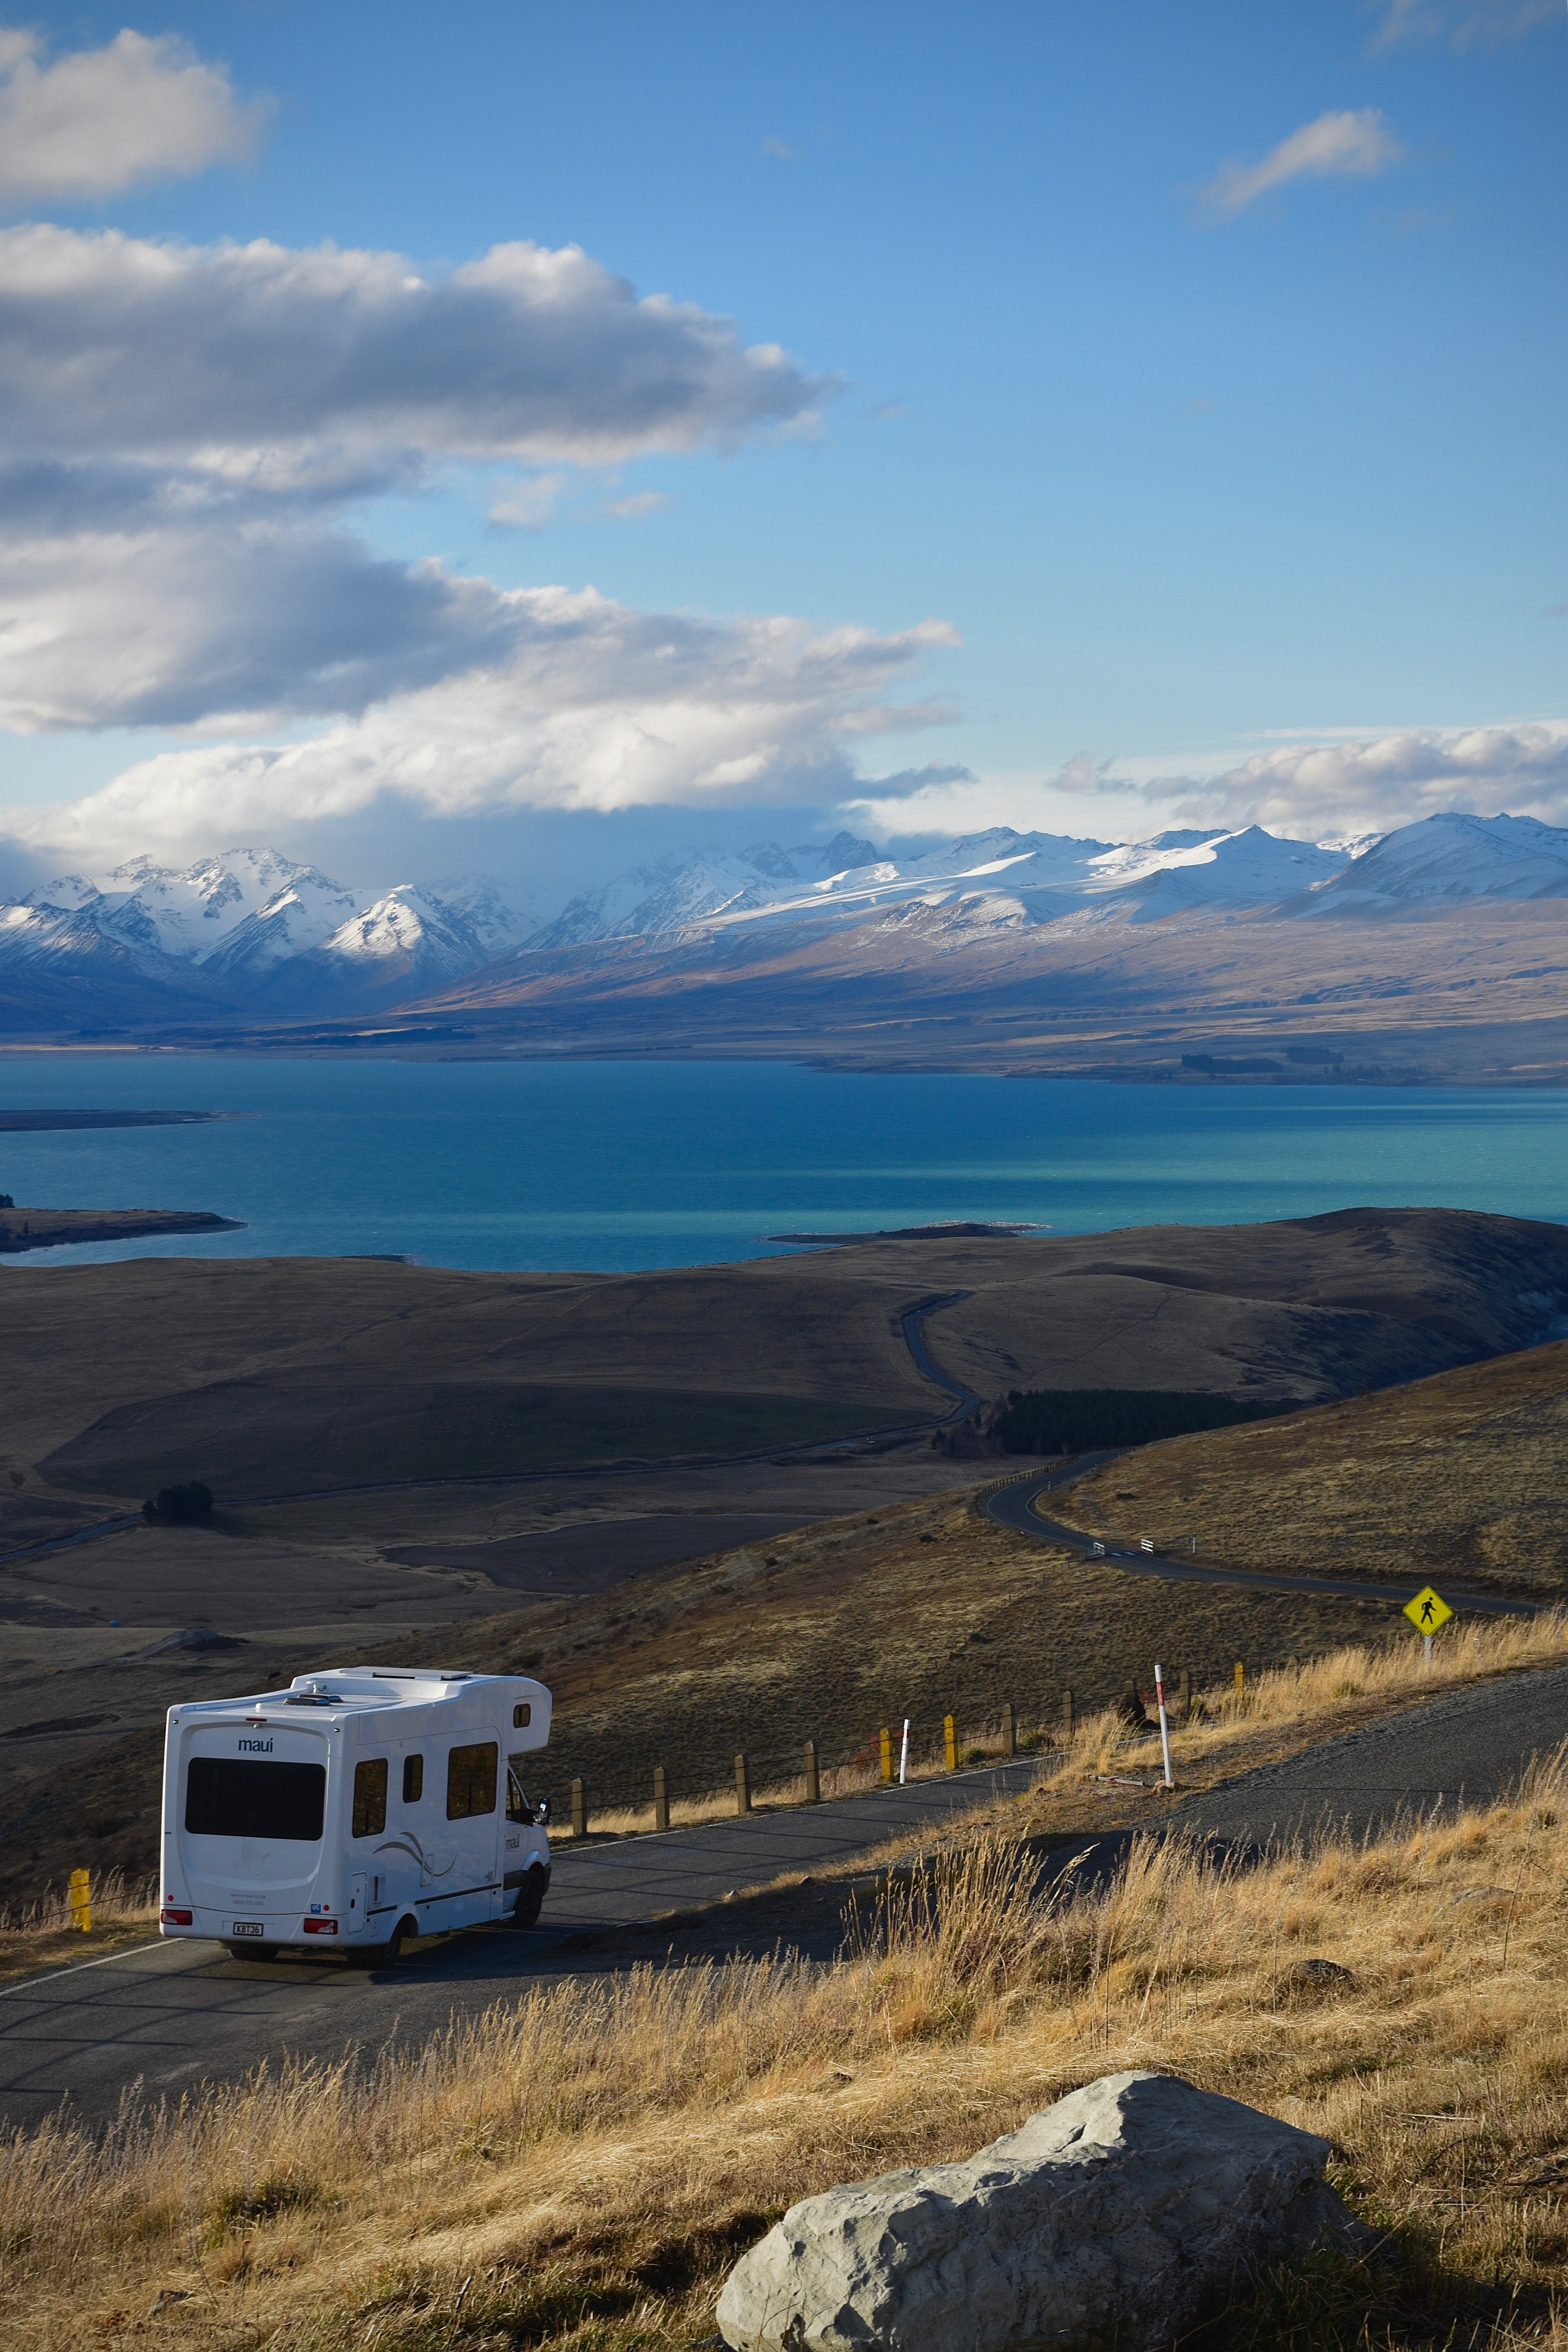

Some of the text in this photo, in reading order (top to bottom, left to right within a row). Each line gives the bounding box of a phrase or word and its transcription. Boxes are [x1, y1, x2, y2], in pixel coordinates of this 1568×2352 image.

[238, 1737, 273, 1752] maui
[506, 1834, 520, 1849] maui
[237, 1925, 259, 1934] KBT36
